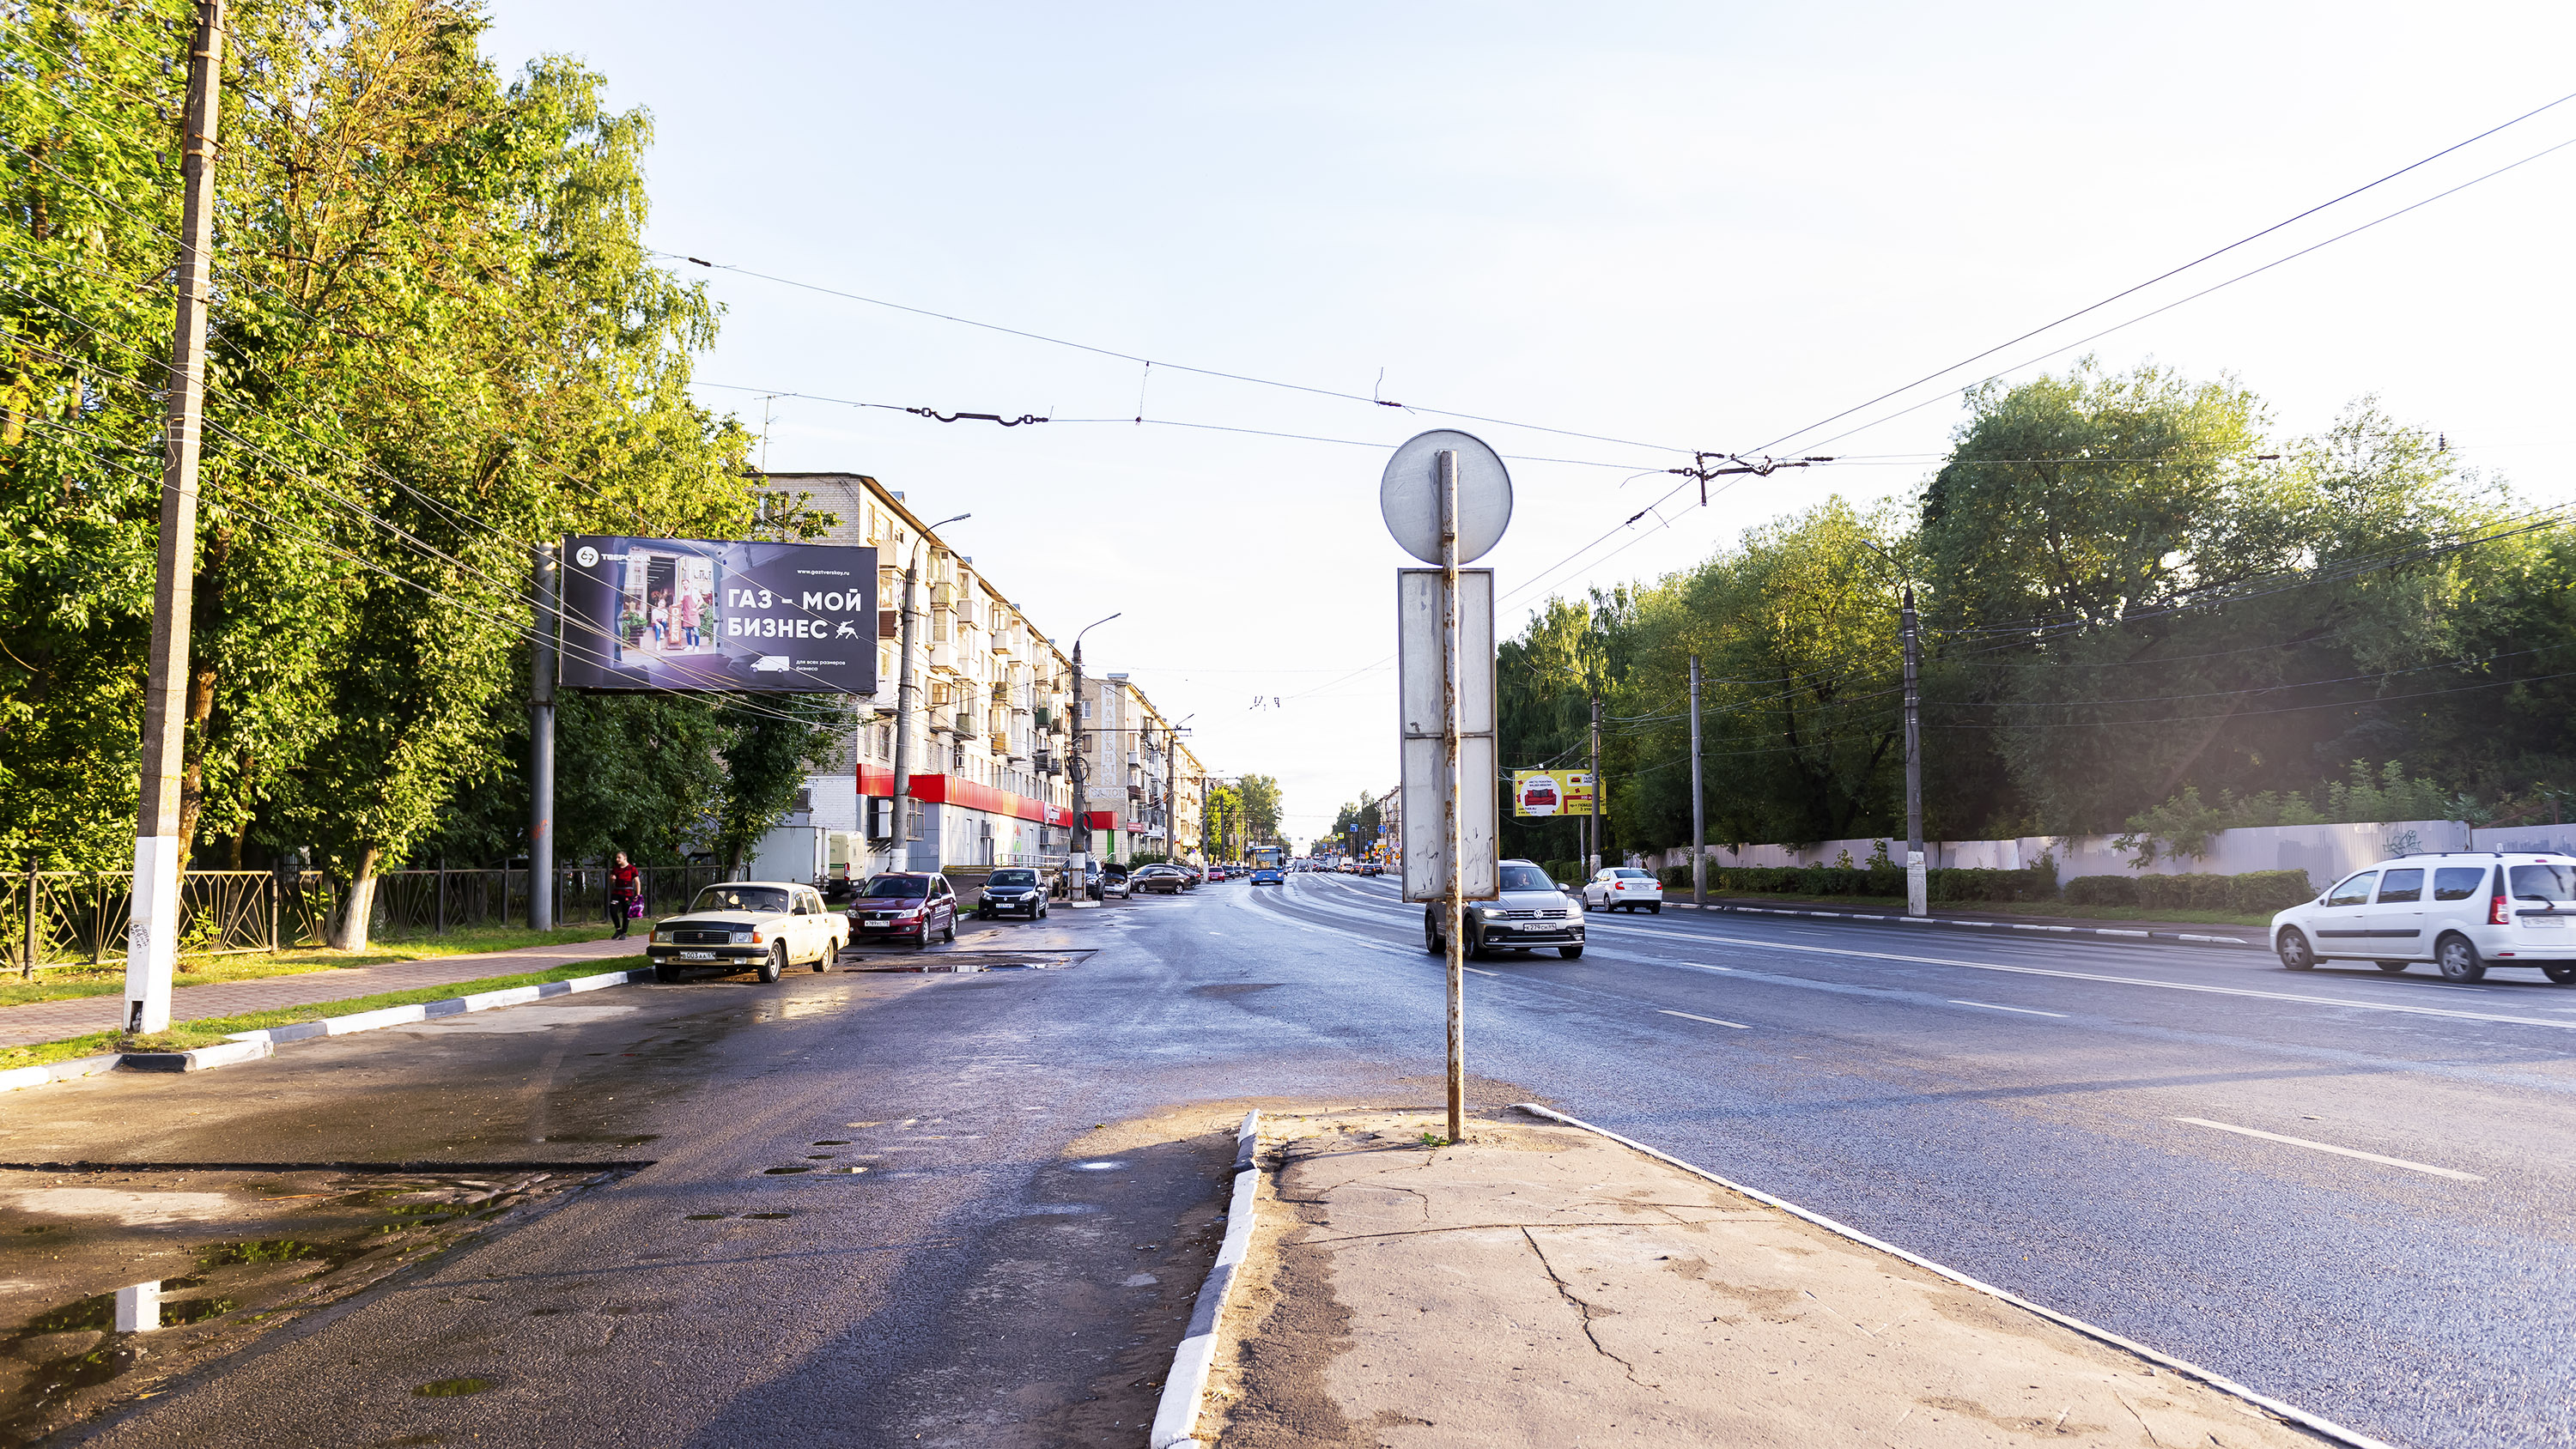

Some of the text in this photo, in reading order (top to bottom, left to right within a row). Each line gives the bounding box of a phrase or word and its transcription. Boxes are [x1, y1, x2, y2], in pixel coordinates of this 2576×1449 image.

[728, 588, 773, 609] ГАЗ
[802, 588, 861, 612] МОЙ
[727, 617, 829, 640] БИЗНЕС
[1090, 788, 1126, 797] САЛОН
